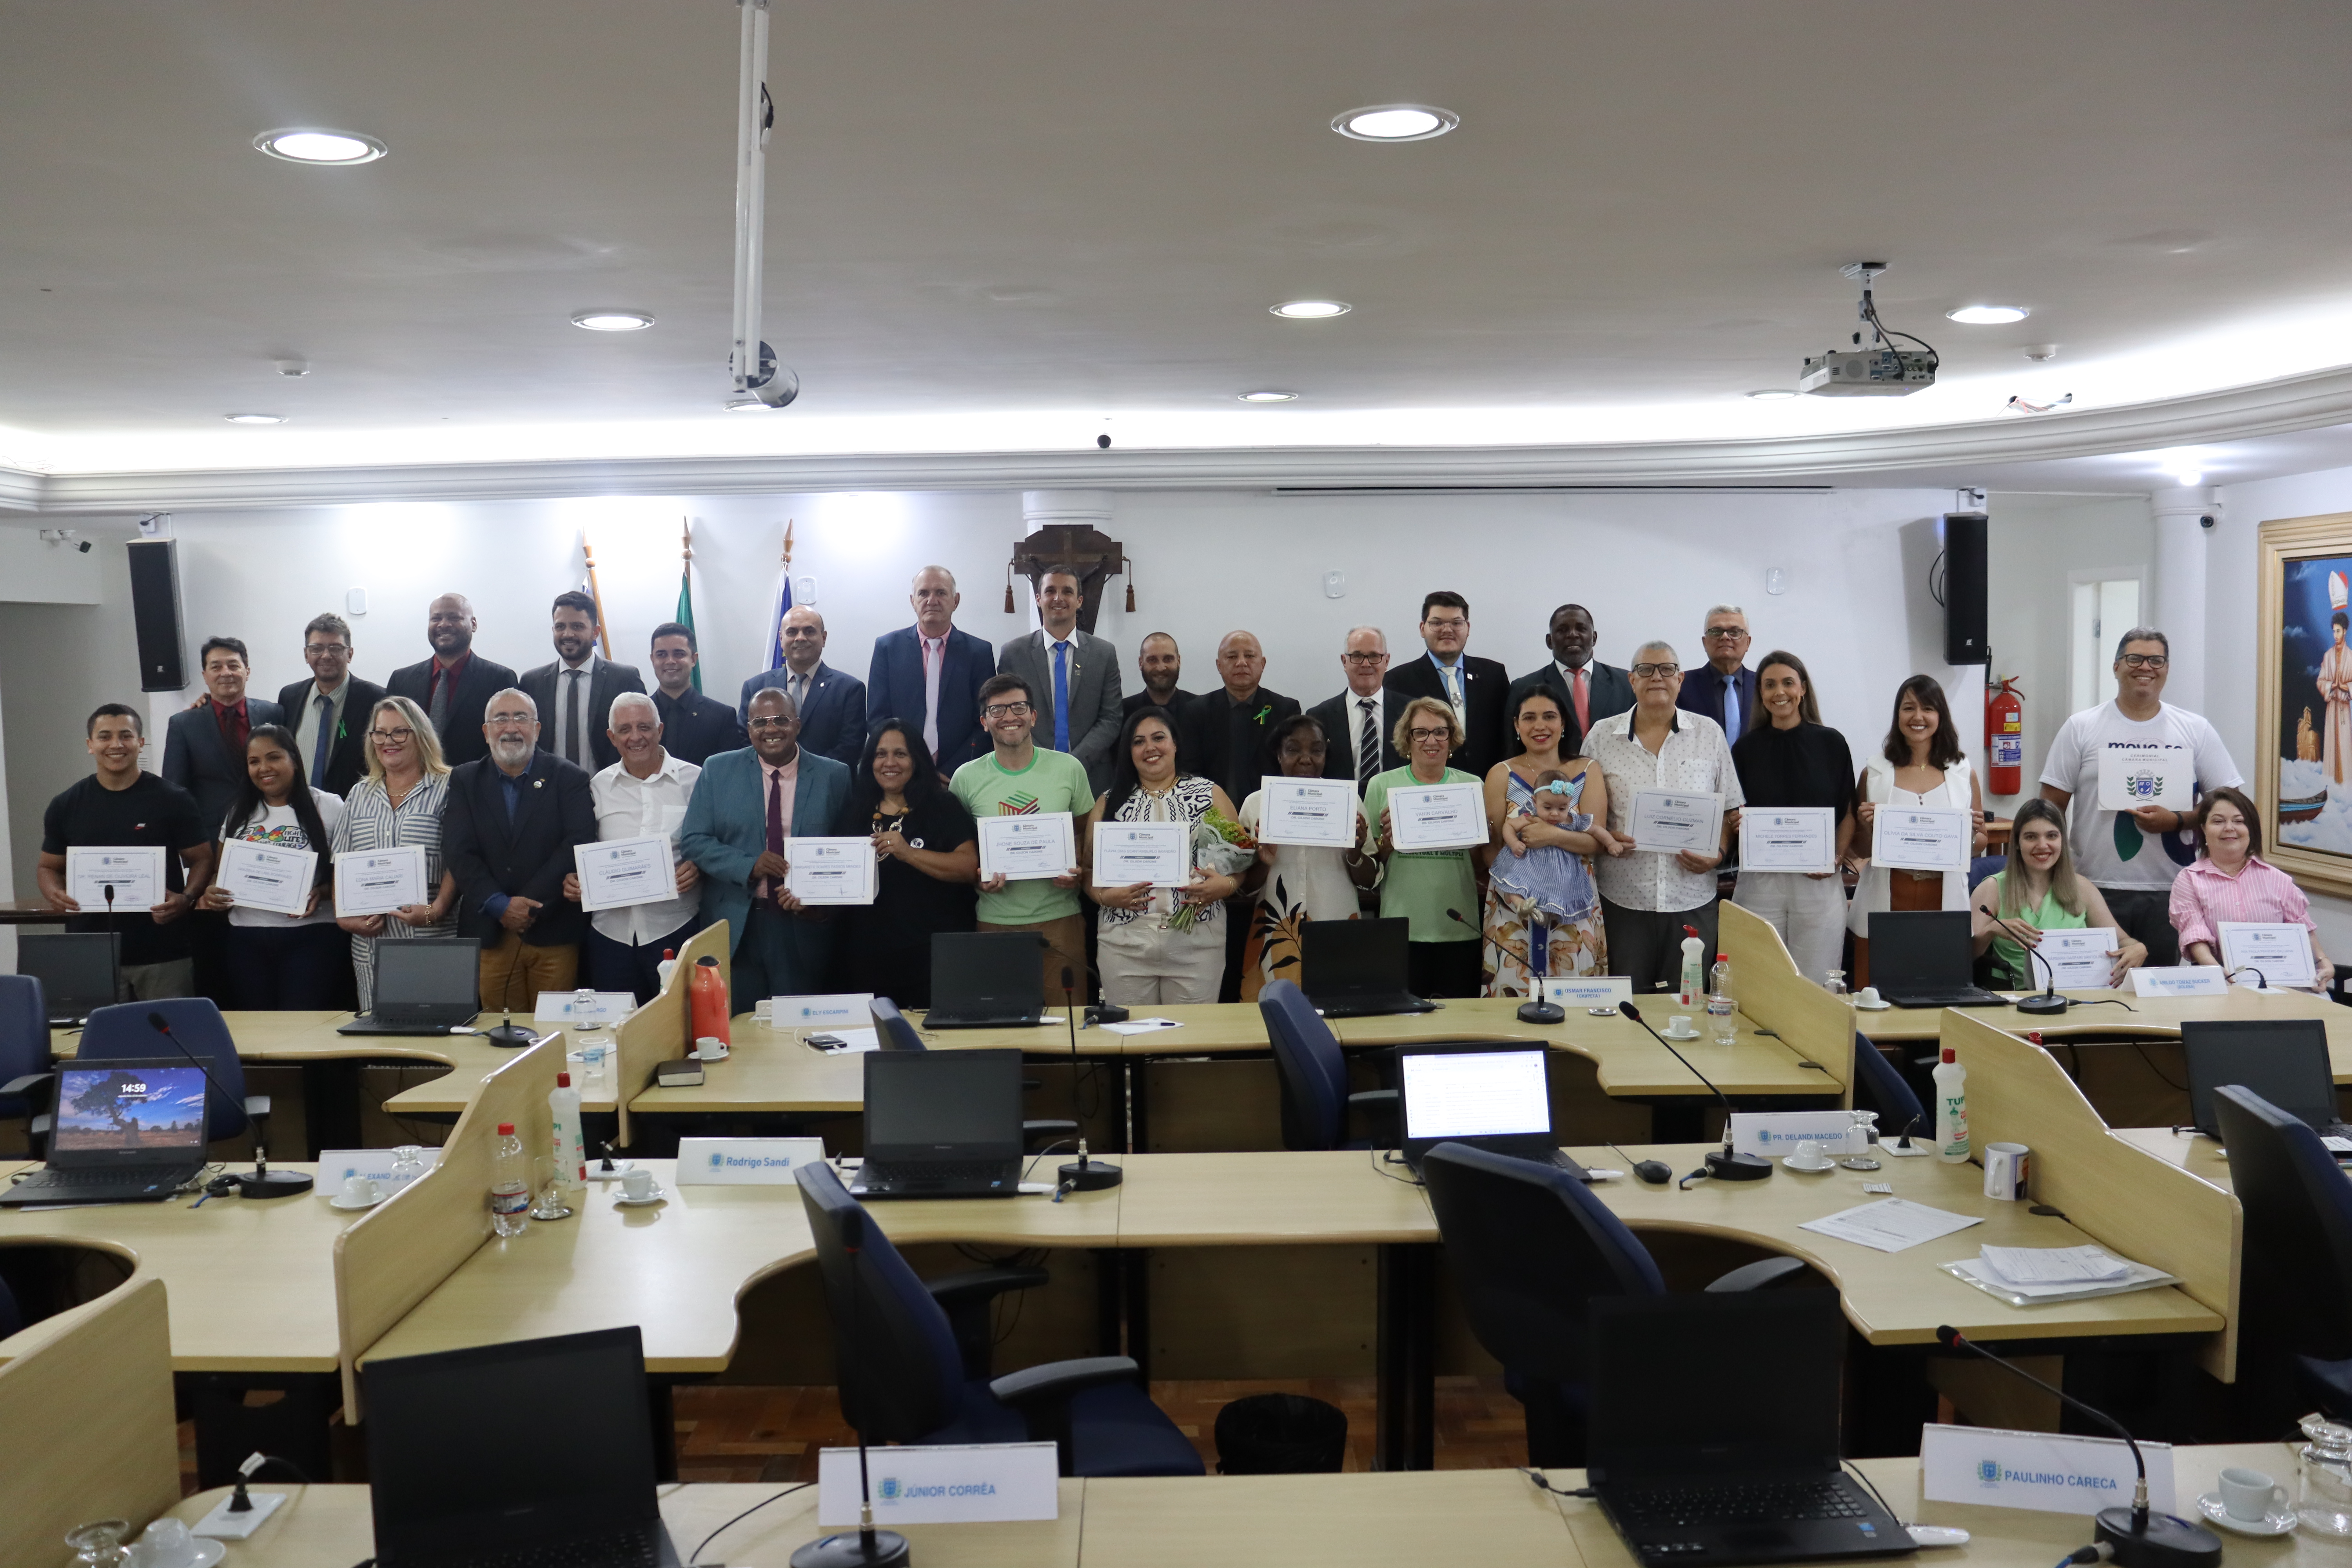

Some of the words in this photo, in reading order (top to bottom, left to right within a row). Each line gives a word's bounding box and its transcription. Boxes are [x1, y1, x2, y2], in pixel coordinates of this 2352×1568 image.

[622, 864, 651, 872] GUIMARÃES
[121, 1083, 147, 1093] 14:59
[1946, 1096, 1965, 1106] TUP
[726, 1157, 761, 1169] Rodrigo
[764, 1157, 789, 1166] Sandi
[2005, 1470, 2064, 1485] PAULINHO
[2067, 1475, 2117, 1490] CARECA
[904, 1484, 946, 1498] JÚNIOR
[949, 1482, 995, 1496] CORRÊA
